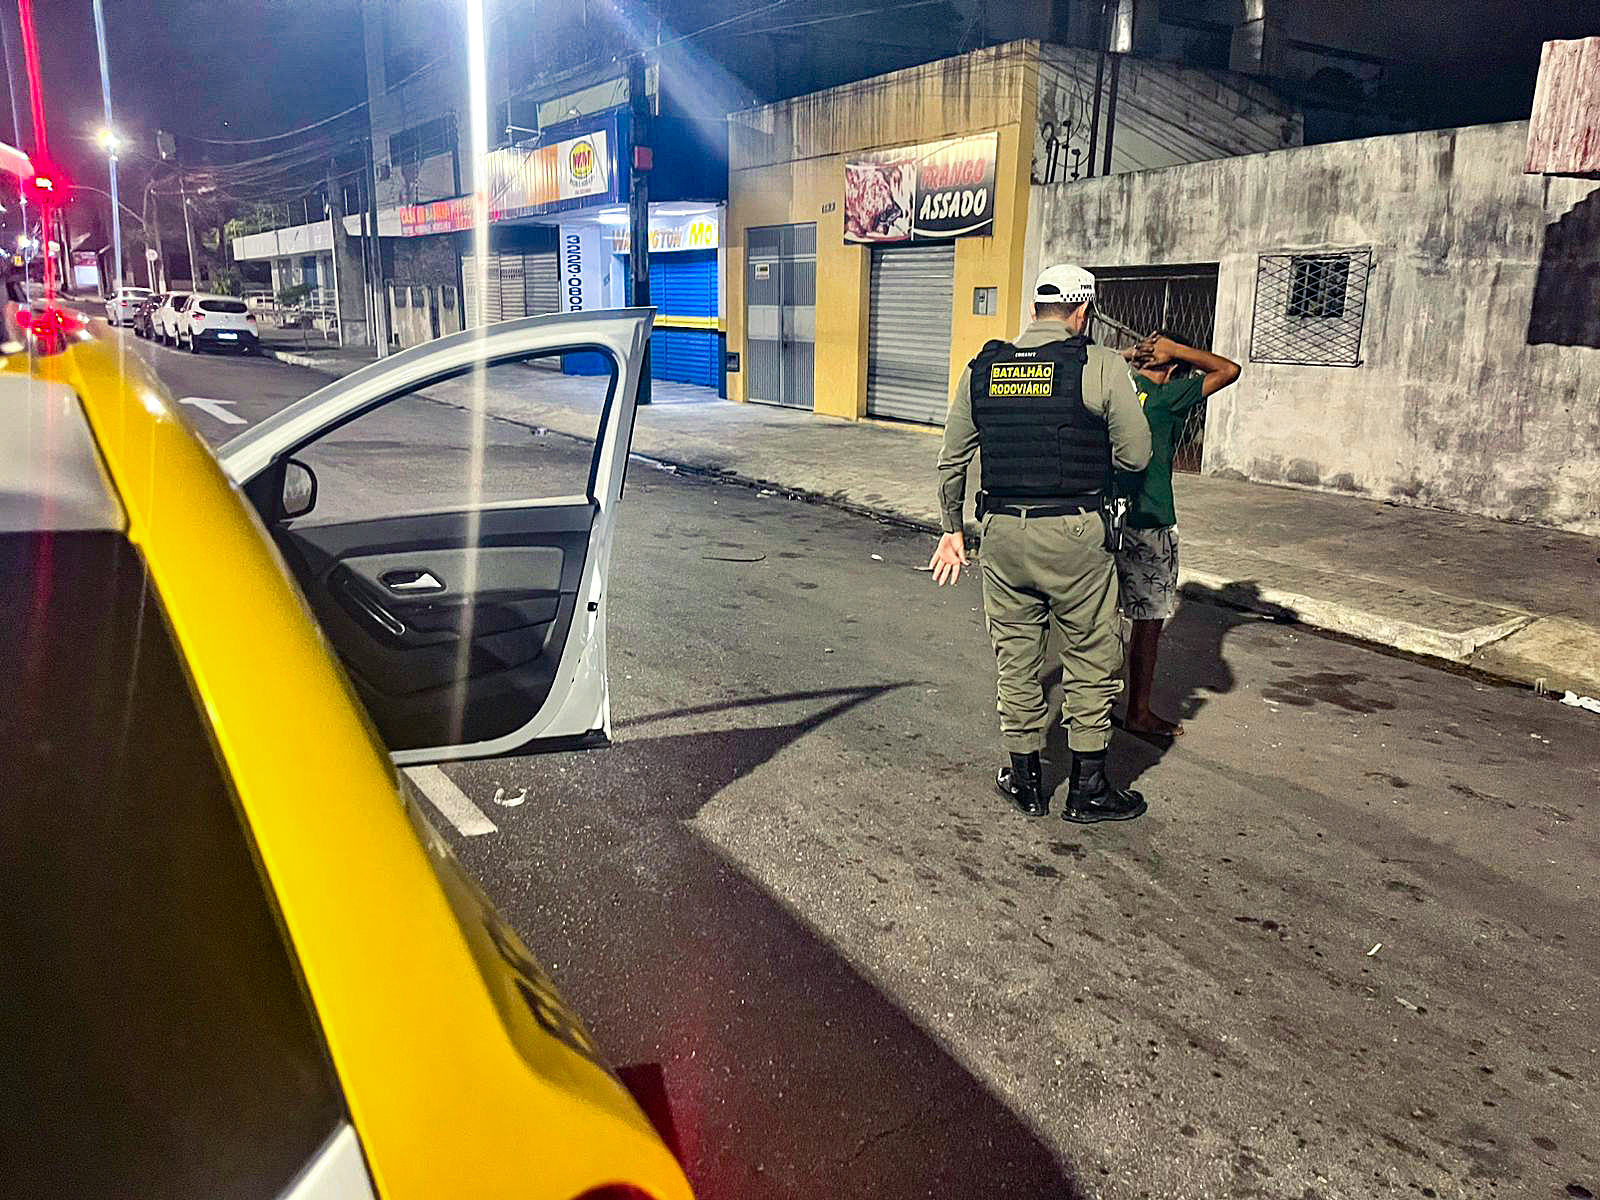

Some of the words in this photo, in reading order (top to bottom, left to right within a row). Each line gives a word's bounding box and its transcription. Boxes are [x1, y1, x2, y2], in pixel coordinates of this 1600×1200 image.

[919, 187, 987, 220] ASSADO
[689, 221, 717, 247] MO
[992, 364, 1052, 378] BATALHÃO
[991, 381, 1050, 395] RODOVIÁRIO
